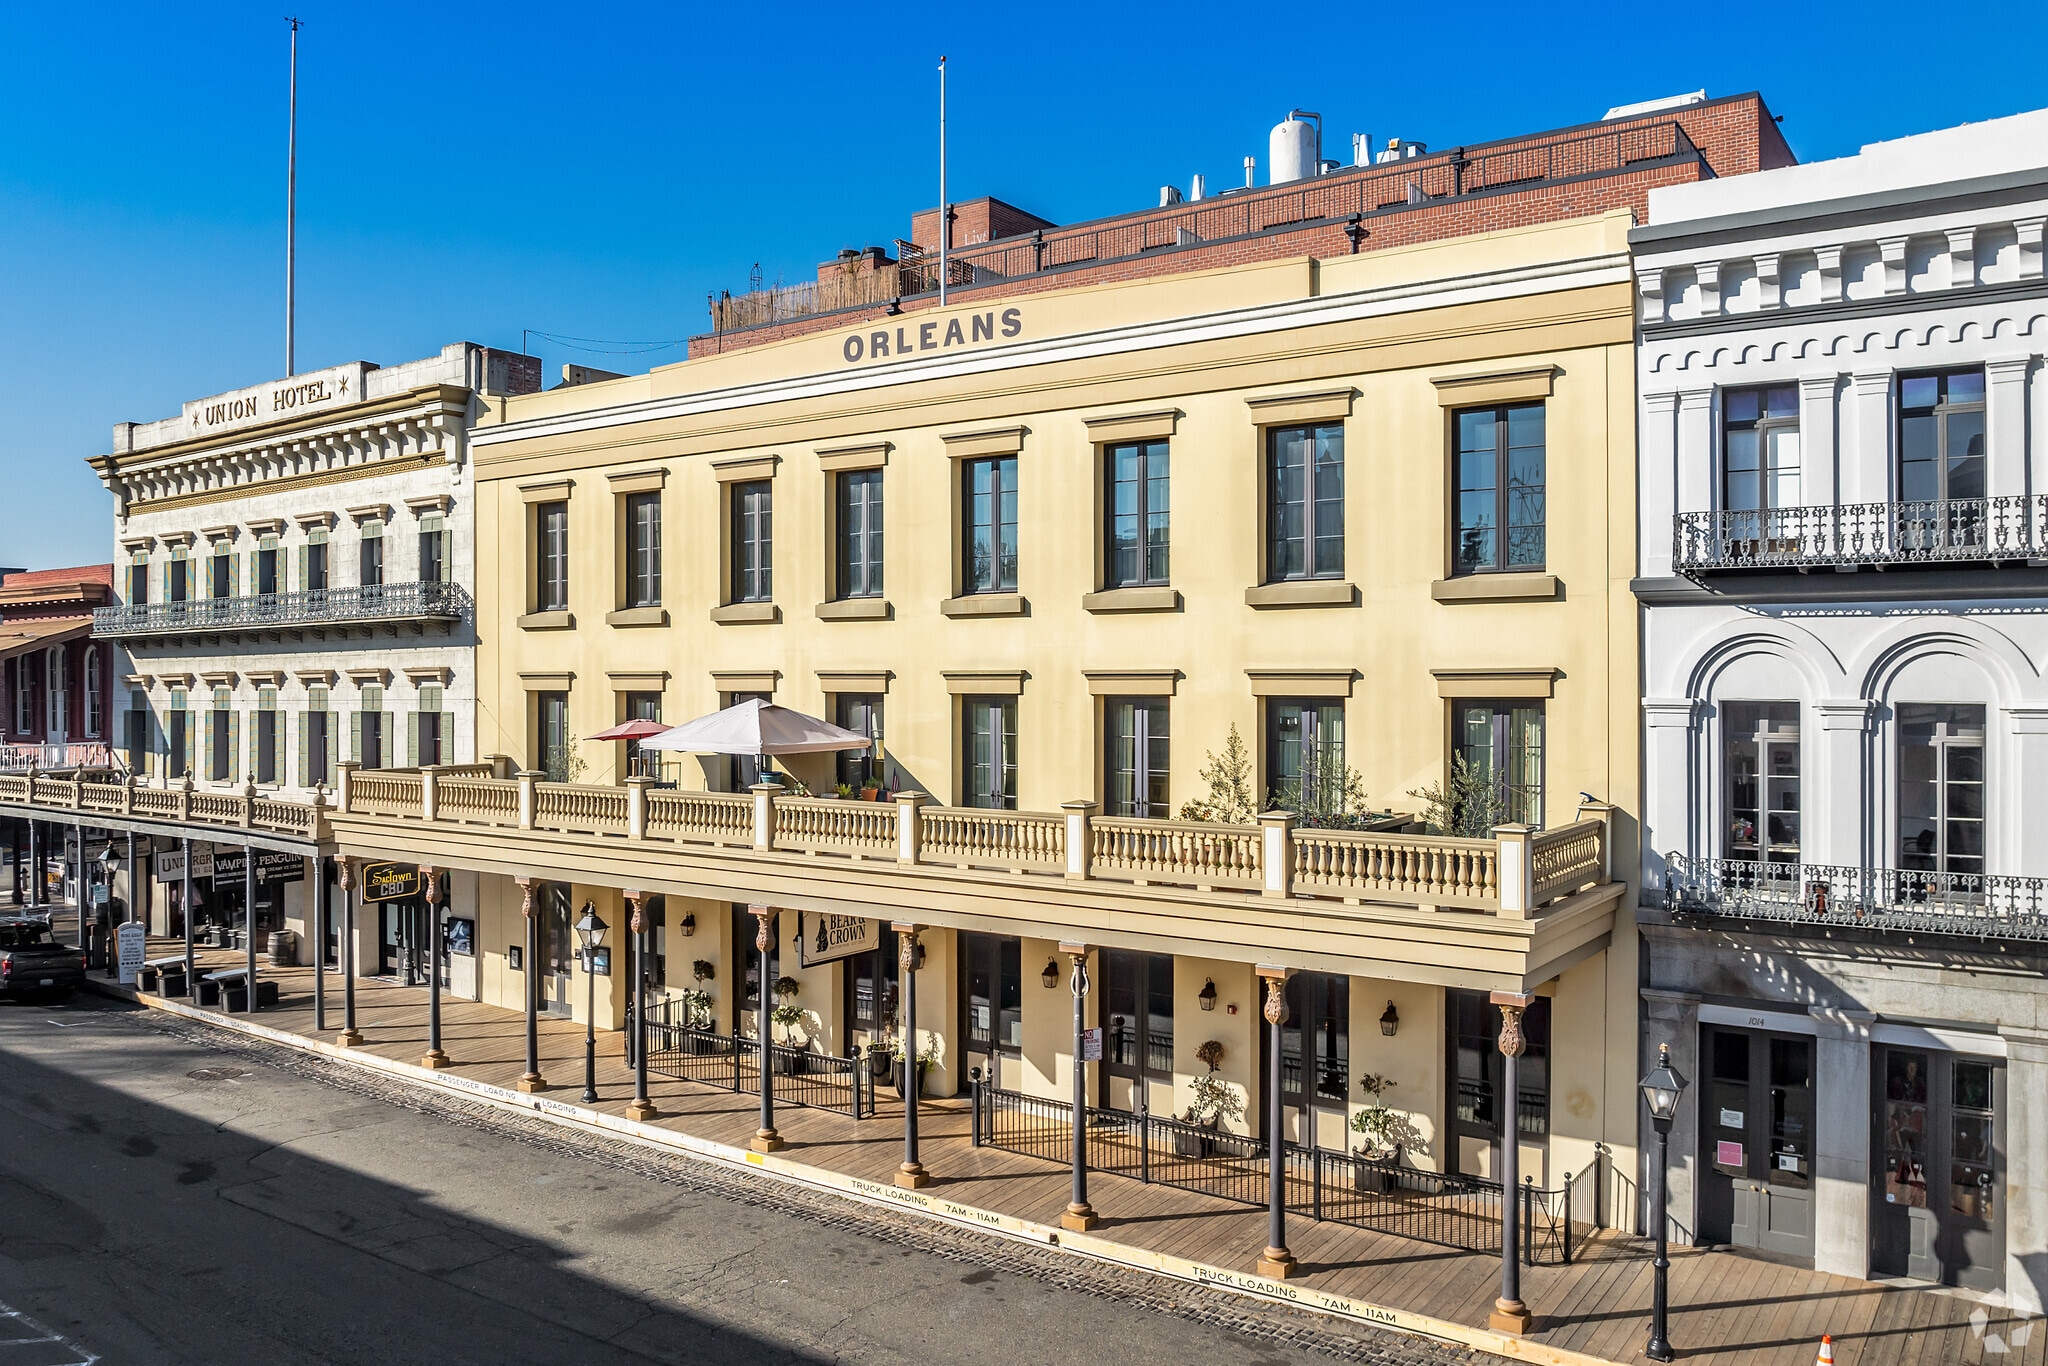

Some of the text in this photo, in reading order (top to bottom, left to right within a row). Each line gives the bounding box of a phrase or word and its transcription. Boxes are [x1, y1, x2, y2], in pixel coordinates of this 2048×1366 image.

[843, 308, 1022, 363] ORLEANS
[205, 381, 332, 426] UNION HOTEL
[161, 854, 213, 872] UNDRGR
[259, 853, 302, 866] PENGUIN
[380, 881, 405, 896] CBD
[830, 914, 857, 930] BEAR
[829, 924, 866, 945] CROWN
[1748, 1017, 1765, 1026] 1014
[1084, 1030, 1093, 1039] NO
[437, 1074, 516, 1100] PASSENGER LOADNG
[542, 1100, 577, 1115] LOADING
[851, 1180, 882, 1195] TRUCK
[885, 1189, 928, 1206] LOADING
[944, 1204, 967, 1217] 7AM
[976, 1212, 1000, 1225] 11AM
[1192, 1266, 1234, 1285] TRUCK
[1238, 1278, 1297, 1299] LOADING
[1321, 1297, 1351, 1312] 7AM
[1365, 1308, 1397, 1323] 11AM
